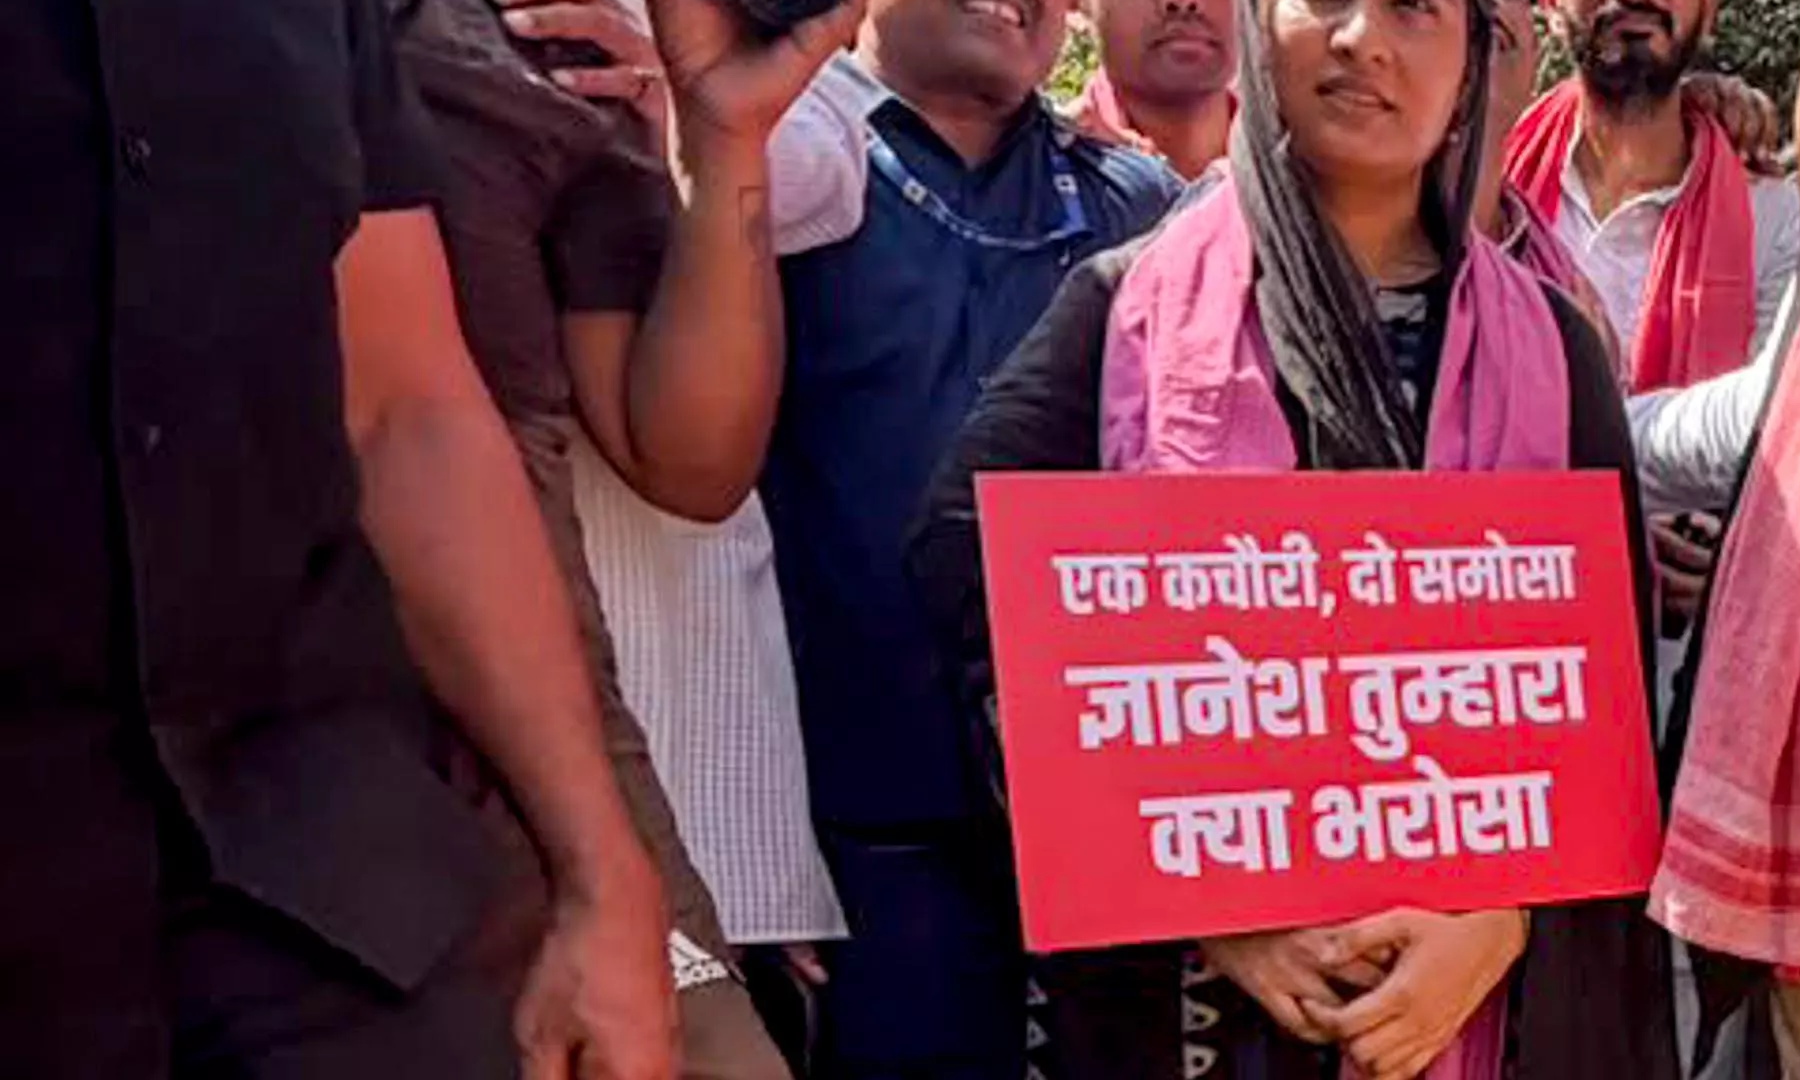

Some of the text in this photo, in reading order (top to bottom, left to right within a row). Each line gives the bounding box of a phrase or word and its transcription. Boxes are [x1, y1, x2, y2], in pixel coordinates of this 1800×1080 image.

[1051, 530, 1576, 618] एक कचौरी, दो समोसा
[1064, 635, 1587, 761] ज्ञानेश तुम्हारा
[1139, 755, 1553, 877] क्या भरोसा
